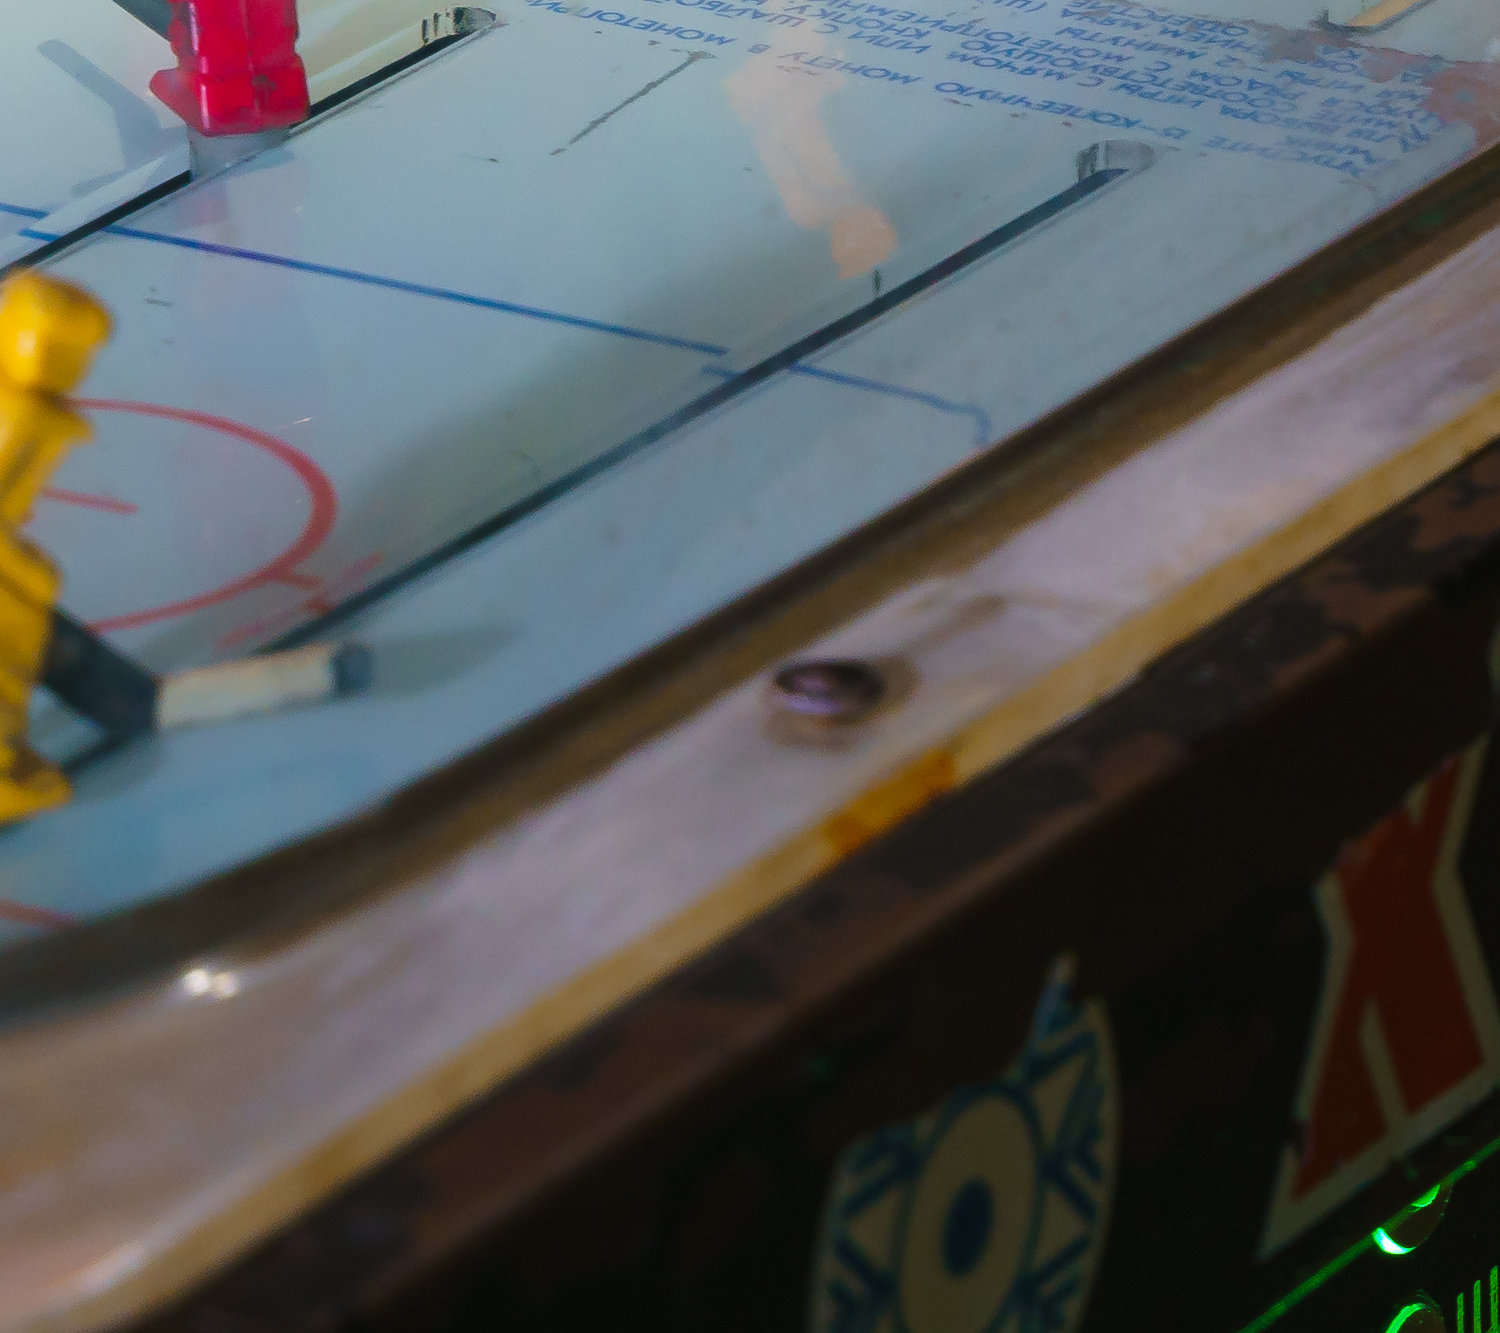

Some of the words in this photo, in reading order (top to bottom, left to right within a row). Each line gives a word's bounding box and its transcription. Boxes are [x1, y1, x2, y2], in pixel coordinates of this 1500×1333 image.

[813, 22, 840, 35] С
[747, 43, 771, 54] В
[846, 30, 931, 54] ИЛИ
[1054, 26, 1204, 60] МИНУТЫ
[782, 51, 921, 84] МОНЕТУ
[946, 50, 1066, 80] МЯЧОМ
[1143, 59, 1173, 73] С
[1074, 75, 1105, 88] С
